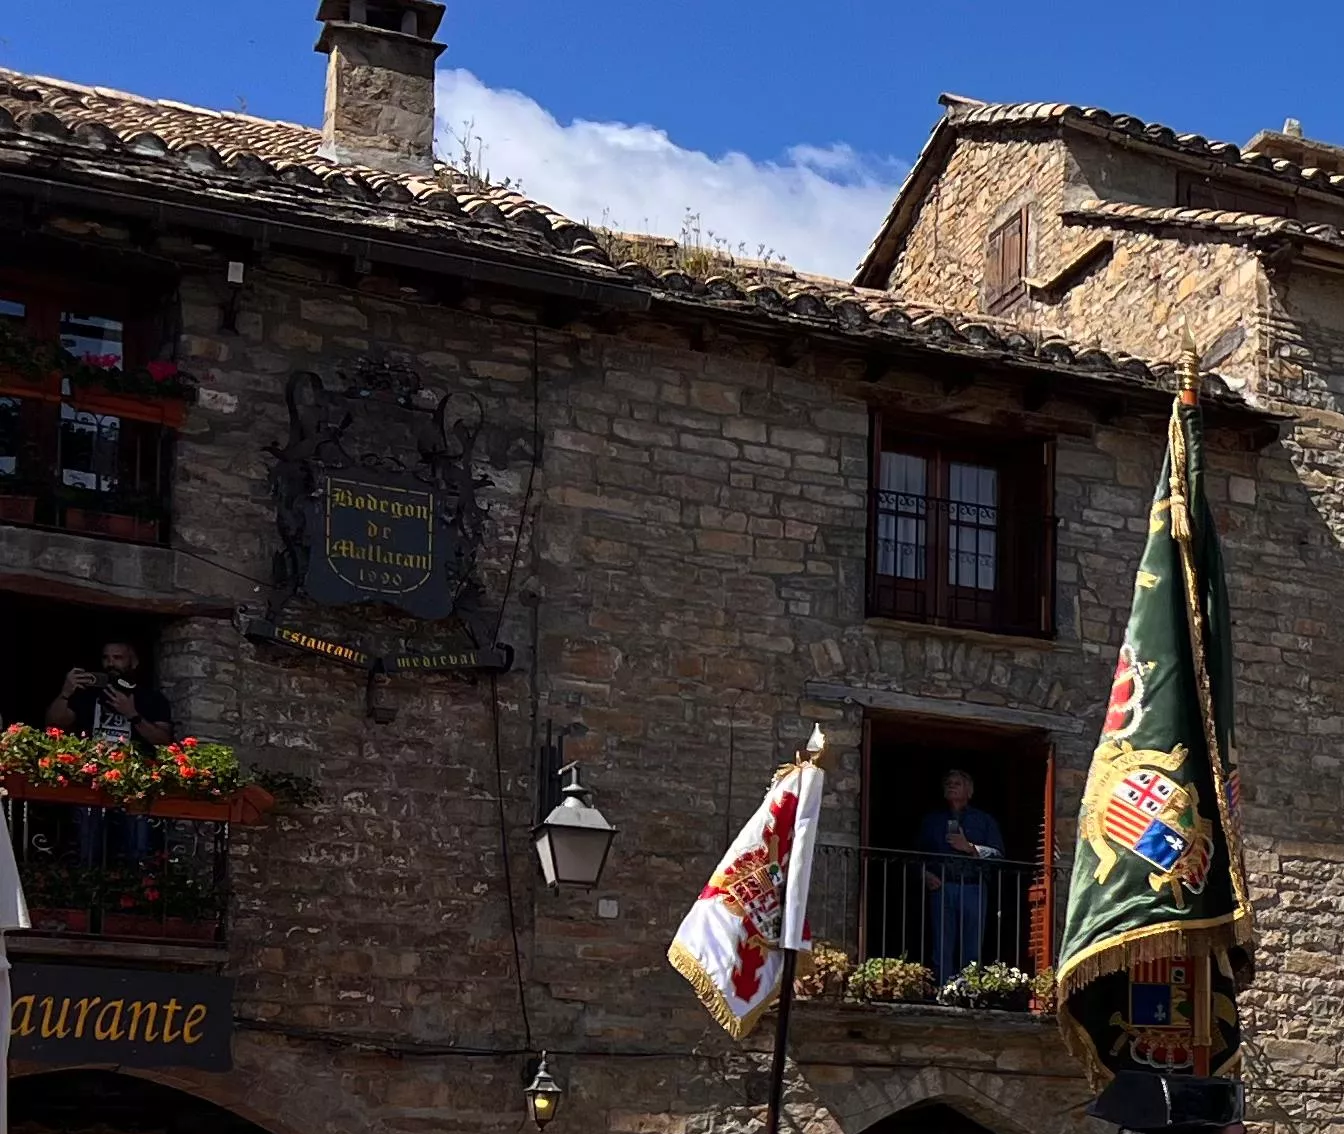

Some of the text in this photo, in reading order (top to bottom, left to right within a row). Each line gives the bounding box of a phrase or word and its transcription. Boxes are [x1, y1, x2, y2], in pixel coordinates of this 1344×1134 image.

[331, 487, 429, 519] Bodegon
[368, 521, 392, 539] de
[274, 626, 368, 664] restaurante
[397, 651, 479, 668] medieval
